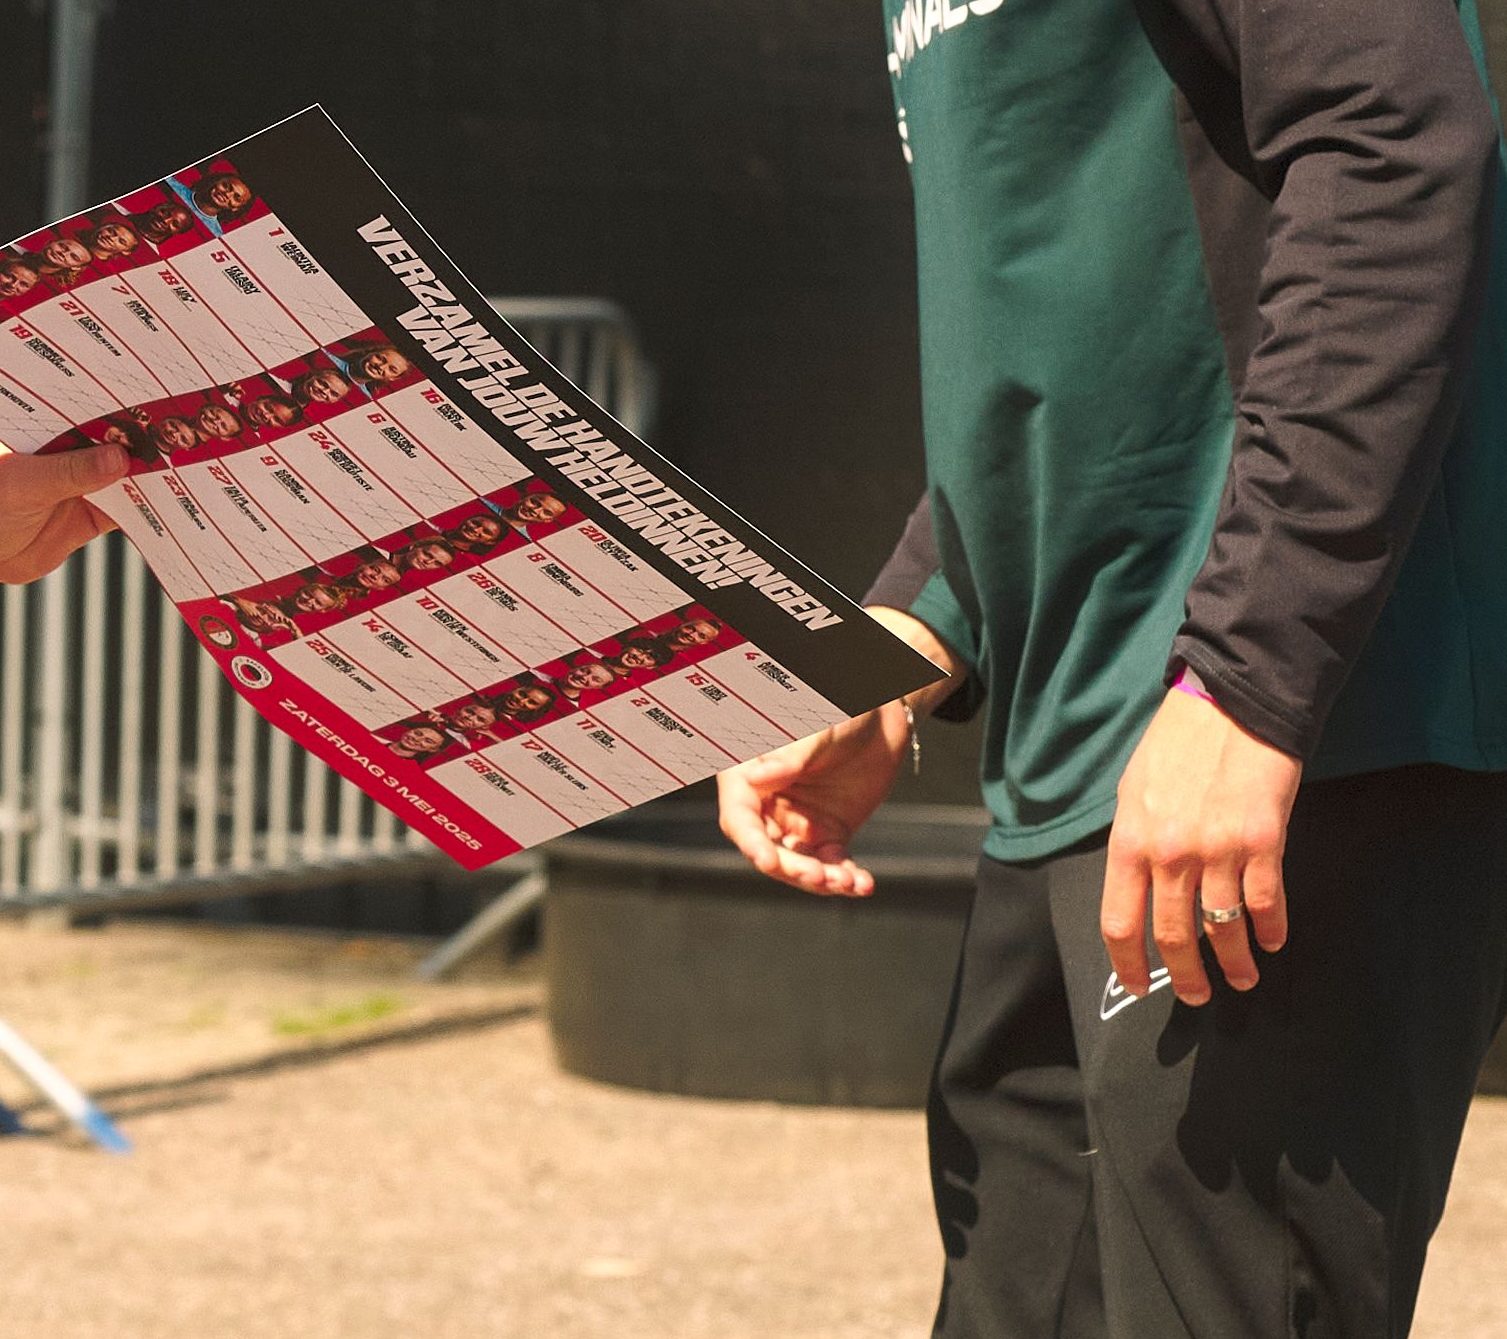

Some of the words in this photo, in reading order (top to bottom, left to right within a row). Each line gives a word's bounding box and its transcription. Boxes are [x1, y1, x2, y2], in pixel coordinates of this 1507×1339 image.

[268, 226, 285, 237] 1
[209, 250, 231, 263] 5
[157, 268, 180, 285] 18
[110, 284, 130, 295] 7
[58, 299, 85, 316] 21
[8, 323, 33, 339] 19
[419, 386, 445, 404] 16
[356, 214, 529, 388] VERZAMEL
[513, 382, 578, 425] DE
[553, 418, 844, 631] HANDTEKENINGEN
[366, 412, 387, 424] 6
[307, 430, 335, 450] 24
[395, 303, 480, 374] VAN
[457, 373, 572, 451] JOUW
[545, 447, 744, 591] HELDINNEN!
[259, 455, 279, 466] 9
[206, 465, 233, 485] 27
[161, 474, 186, 496] 23
[577, 524, 607, 543] 20
[525, 551, 547, 563] 8
[466, 571, 496, 589] 26
[415, 595, 440, 610] 10
[361, 617, 384, 633] 14
[304, 638, 334, 656] 25
[744, 651, 761, 660] 4
[684, 671, 709, 686] 15
[629, 696, 650, 707] 2
[575, 717, 597, 730] 11
[520, 738, 544, 751] 17
[278, 698, 385, 779] ZATERDAG
[383, 775, 400, 788] 3
[396, 785, 435, 815] MEI
[431, 813, 483, 851] 2025
